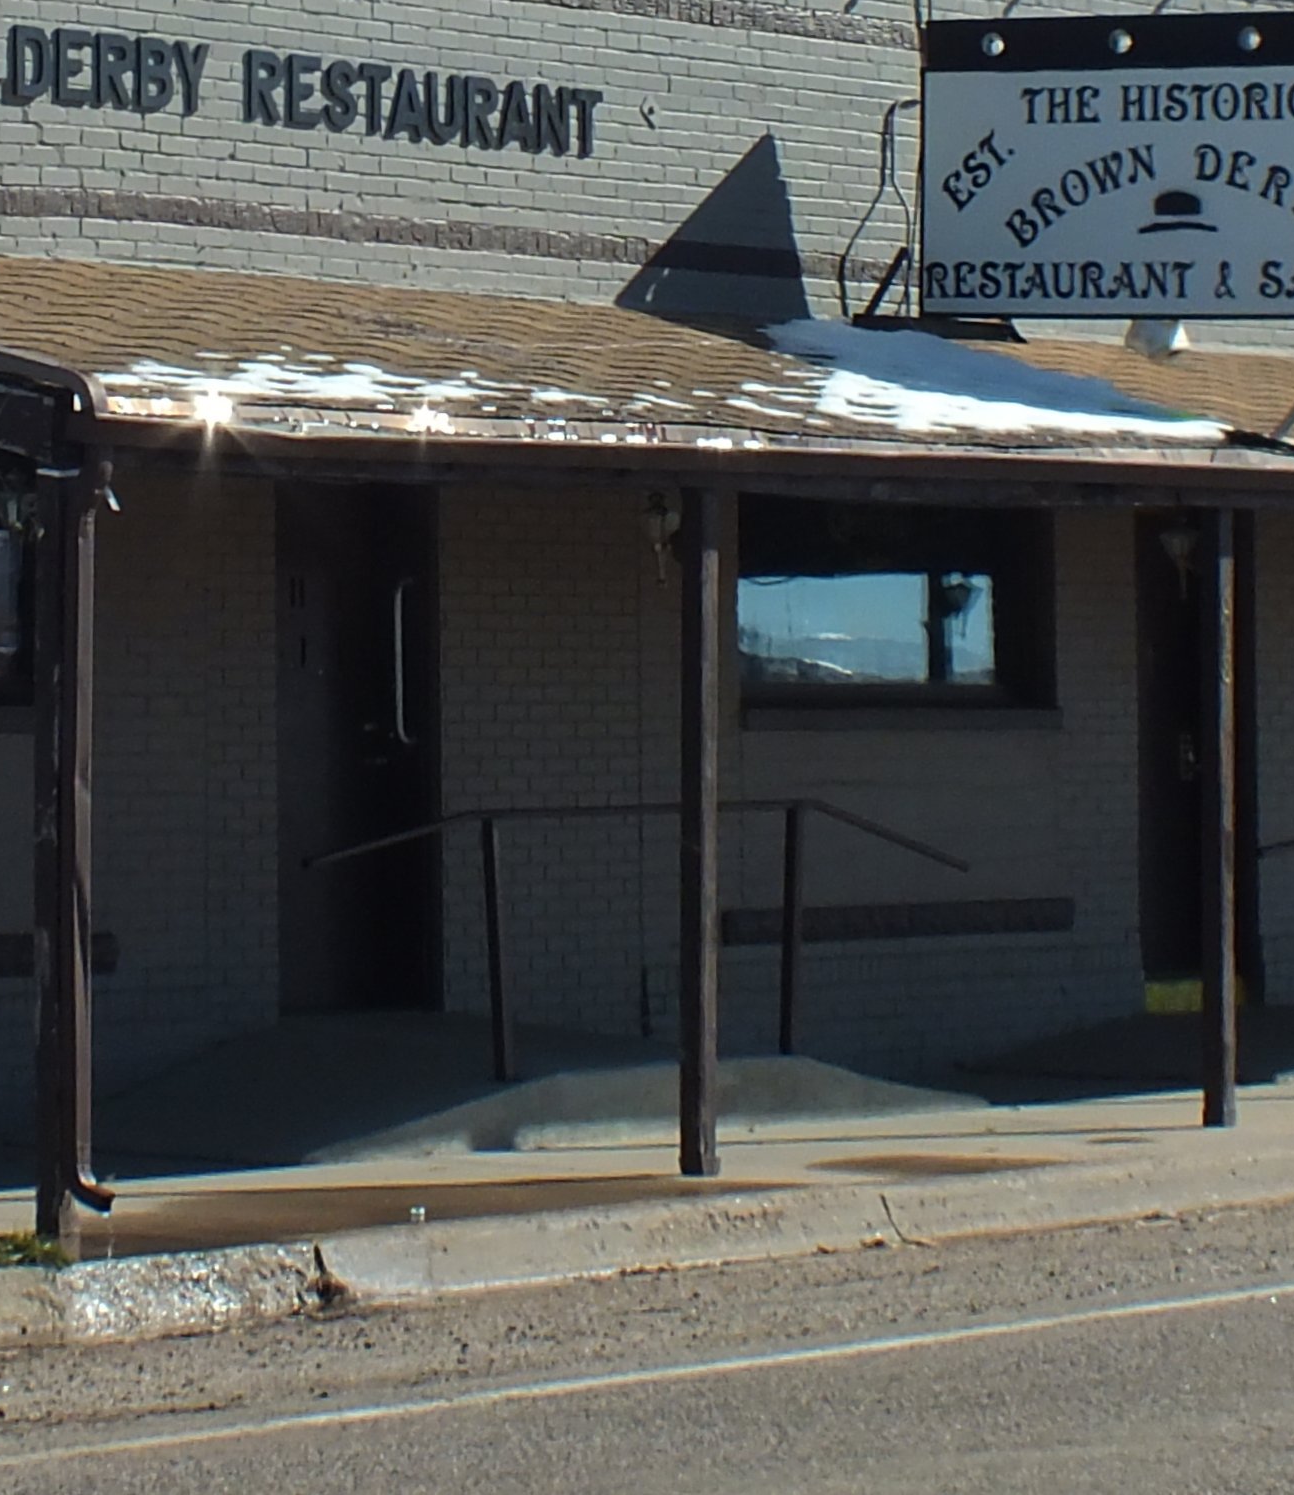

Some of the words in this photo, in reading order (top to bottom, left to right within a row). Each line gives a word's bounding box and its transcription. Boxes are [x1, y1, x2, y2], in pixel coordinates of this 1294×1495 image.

[1, 24, 209, 116] DERBY
[242, 49, 603, 159] RESTAURANT
[1021, 85, 1101, 124] THE
[941, 128, 1015, 212] EST.
[1004, 143, 1157, 249] BROWN
[924, 261, 1195, 300] RESTAURANT
[1214, 261, 1236, 300] &
